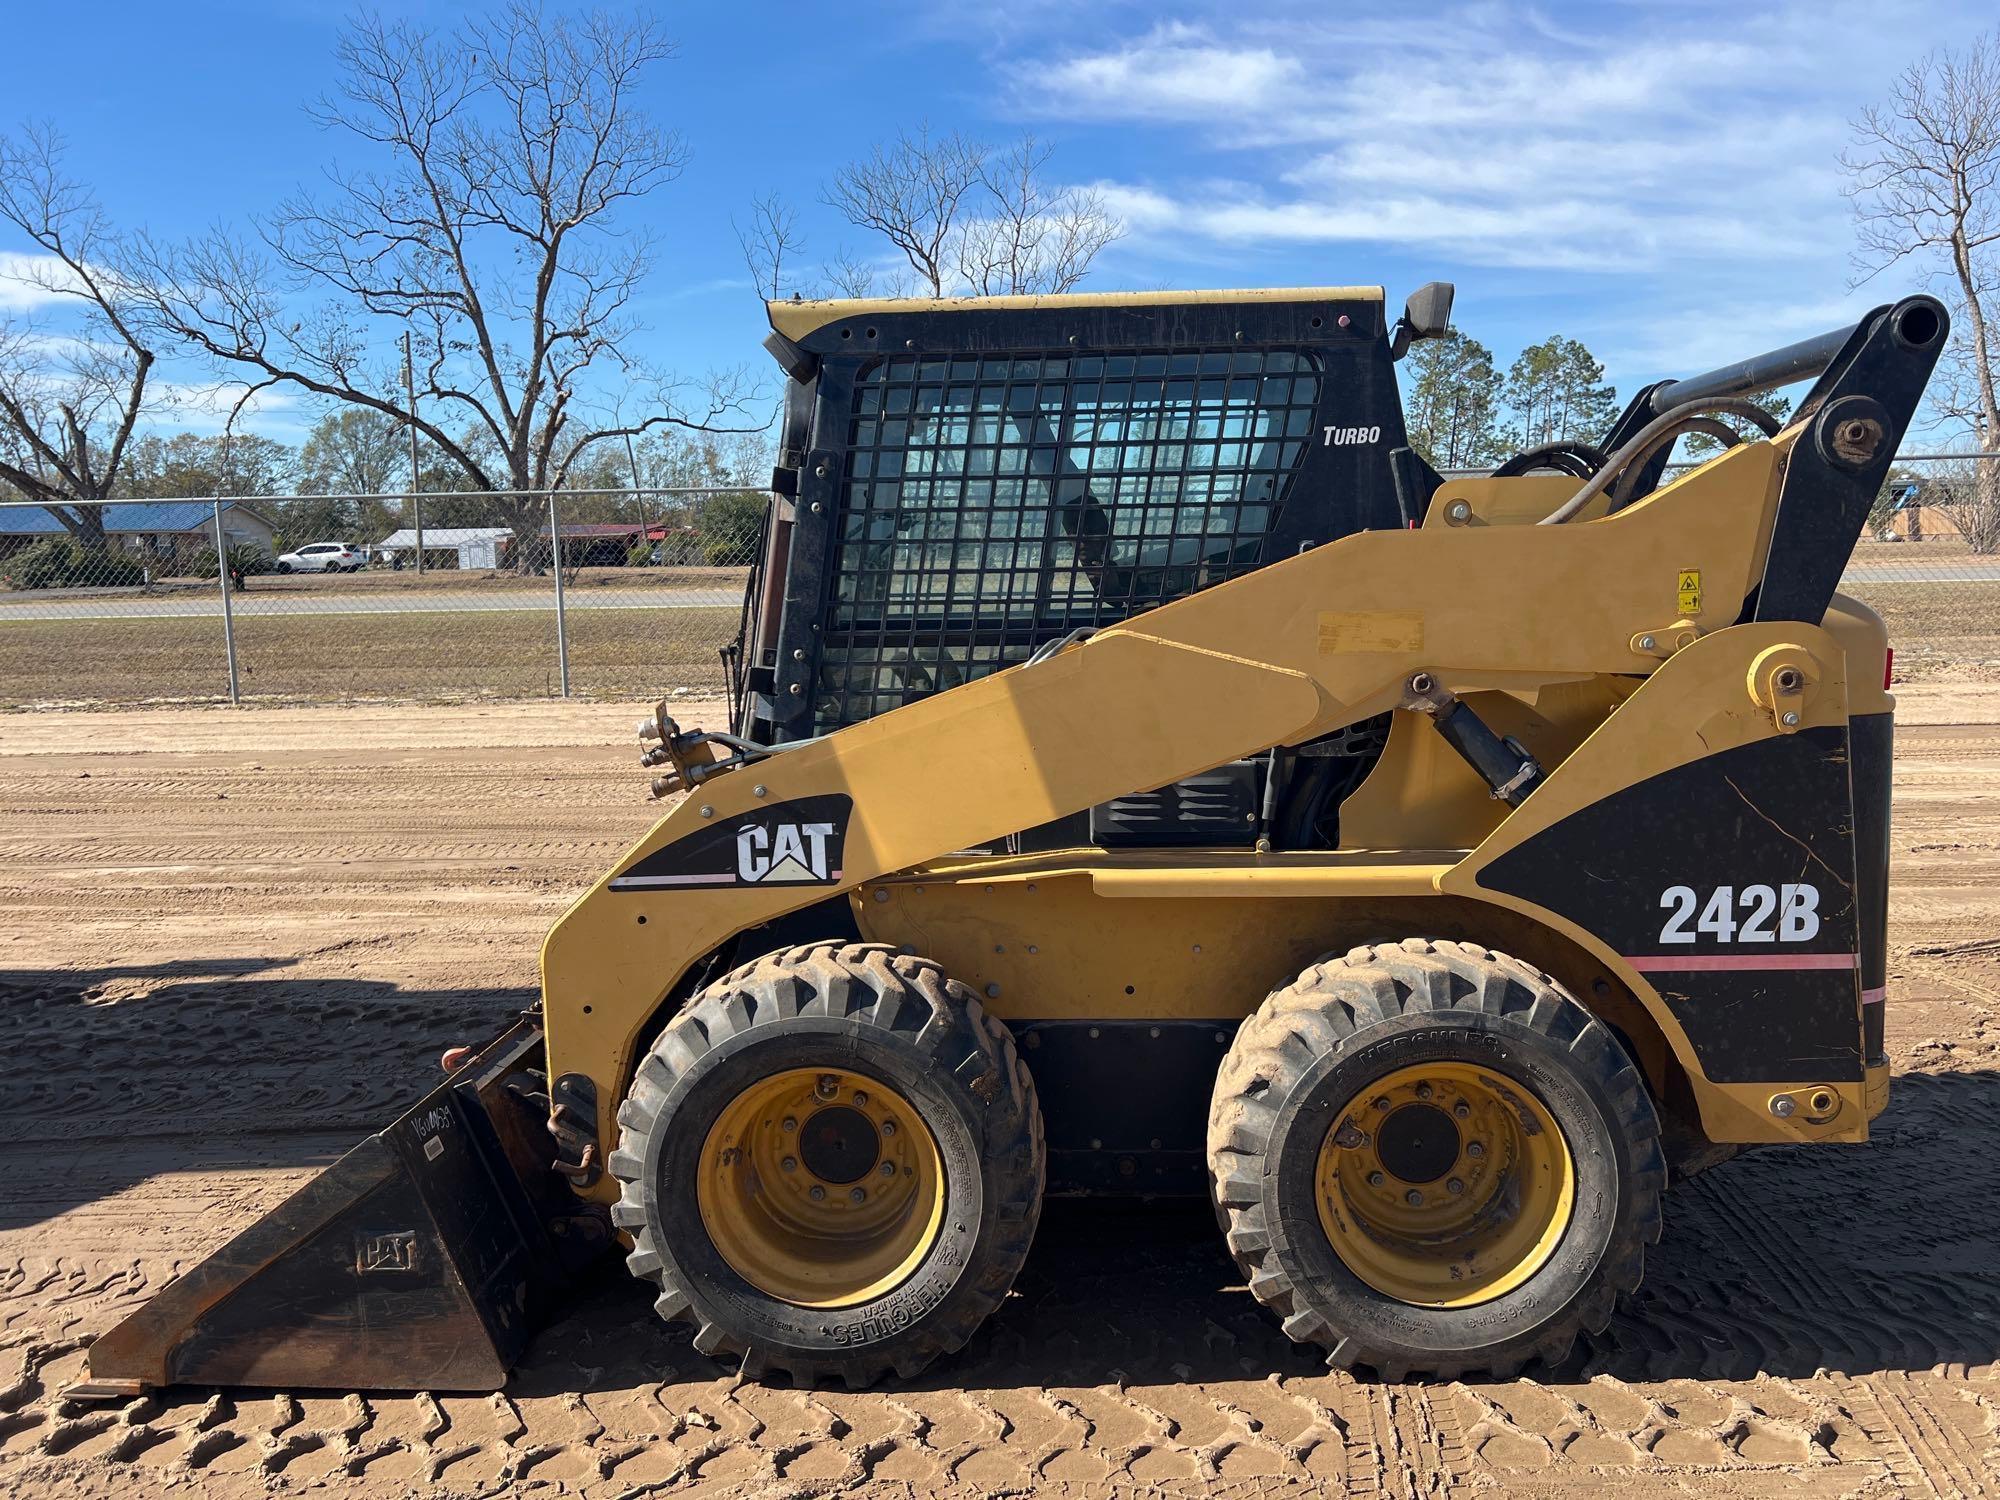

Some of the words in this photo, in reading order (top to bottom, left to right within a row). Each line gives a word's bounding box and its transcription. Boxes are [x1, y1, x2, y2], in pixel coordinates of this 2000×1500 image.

[1323, 425, 1381, 446] TURBO
[736, 822, 833, 882] CAT
[1658, 883, 1820, 944] 242B
[832, 1271, 950, 1345] HERCULES
